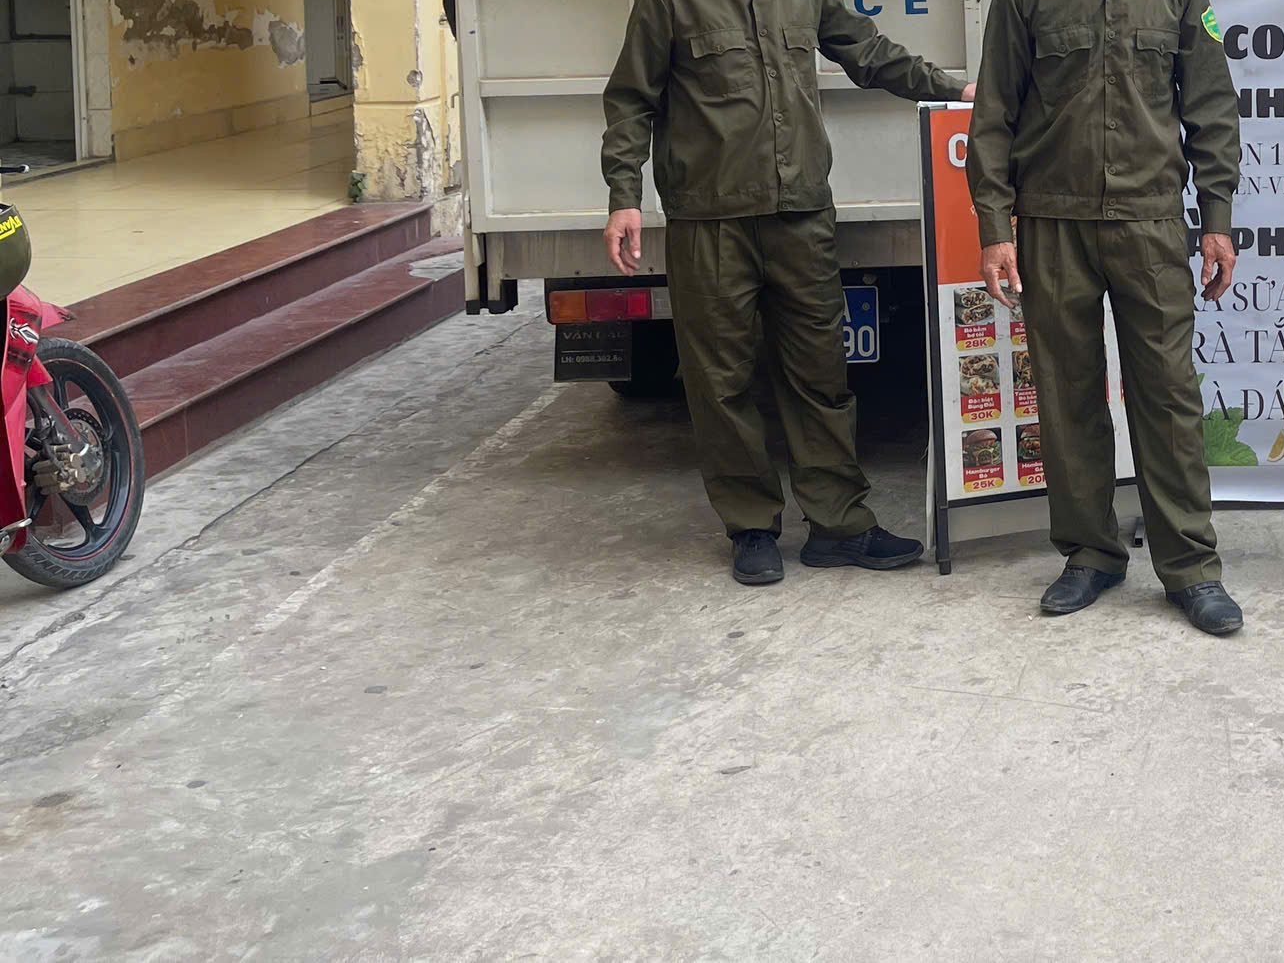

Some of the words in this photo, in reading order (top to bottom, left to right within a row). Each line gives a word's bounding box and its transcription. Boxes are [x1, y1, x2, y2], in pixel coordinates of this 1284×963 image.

[965, 339, 988, 349] 28K
[971, 410, 993, 421] 30K
[965, 467, 1000, 476] Hamburger
[973, 480, 995, 490] 25K
